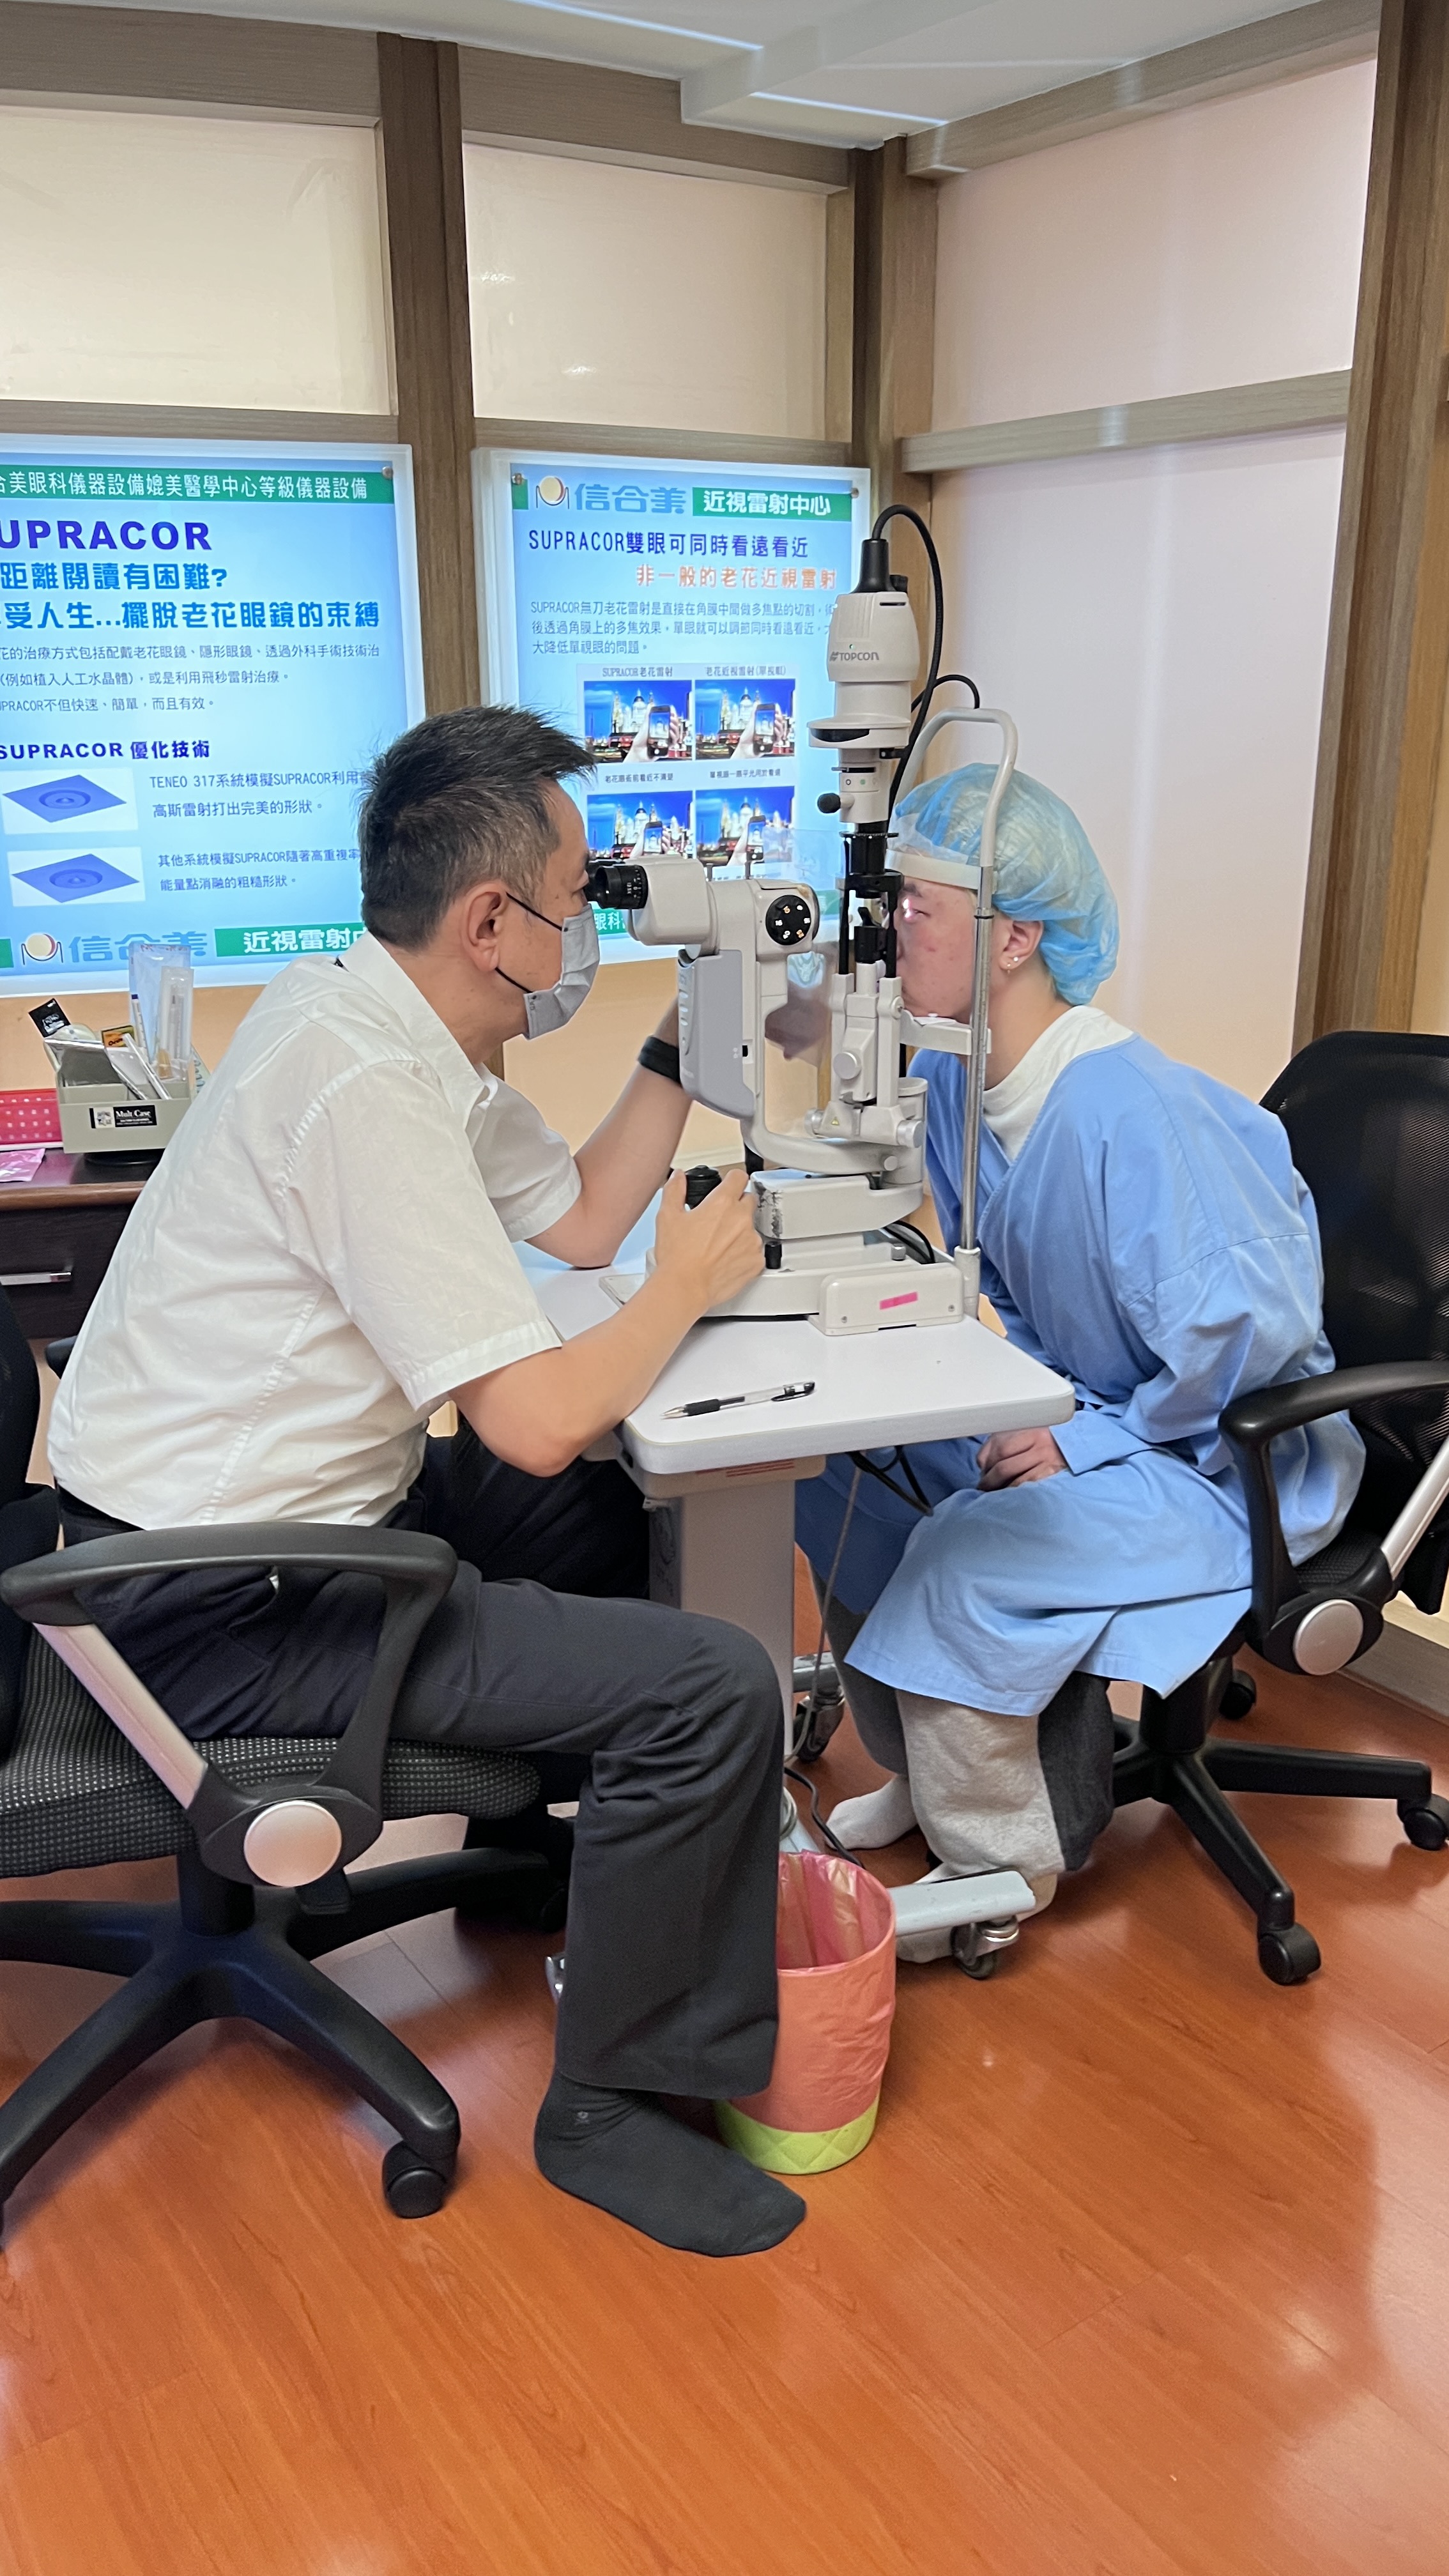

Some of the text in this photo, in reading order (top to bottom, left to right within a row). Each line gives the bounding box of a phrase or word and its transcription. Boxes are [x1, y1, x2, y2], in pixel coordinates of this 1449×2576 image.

[574, 483, 686, 514] 信合美
[703, 491, 831, 516] 近視雷射中心
[529, 530, 808, 558] SUPRACOR雙眼可同時看遠看近
[0, 562, 227, 590] 距離閱讀有困難?
[636, 564, 836, 590] 非一般的老花近視雷射
[0, 601, 379, 629] 受人生...擺脫老花眼鏡的束縛
[838, 652, 880, 661] TOPCON
[130, 740, 209, 759] 優化技術
[150, 776, 188, 788] TENEO
[152, 800, 322, 818] 高斯雷射打出完美的形狀。
[594, 912, 625, 930] 眼科
